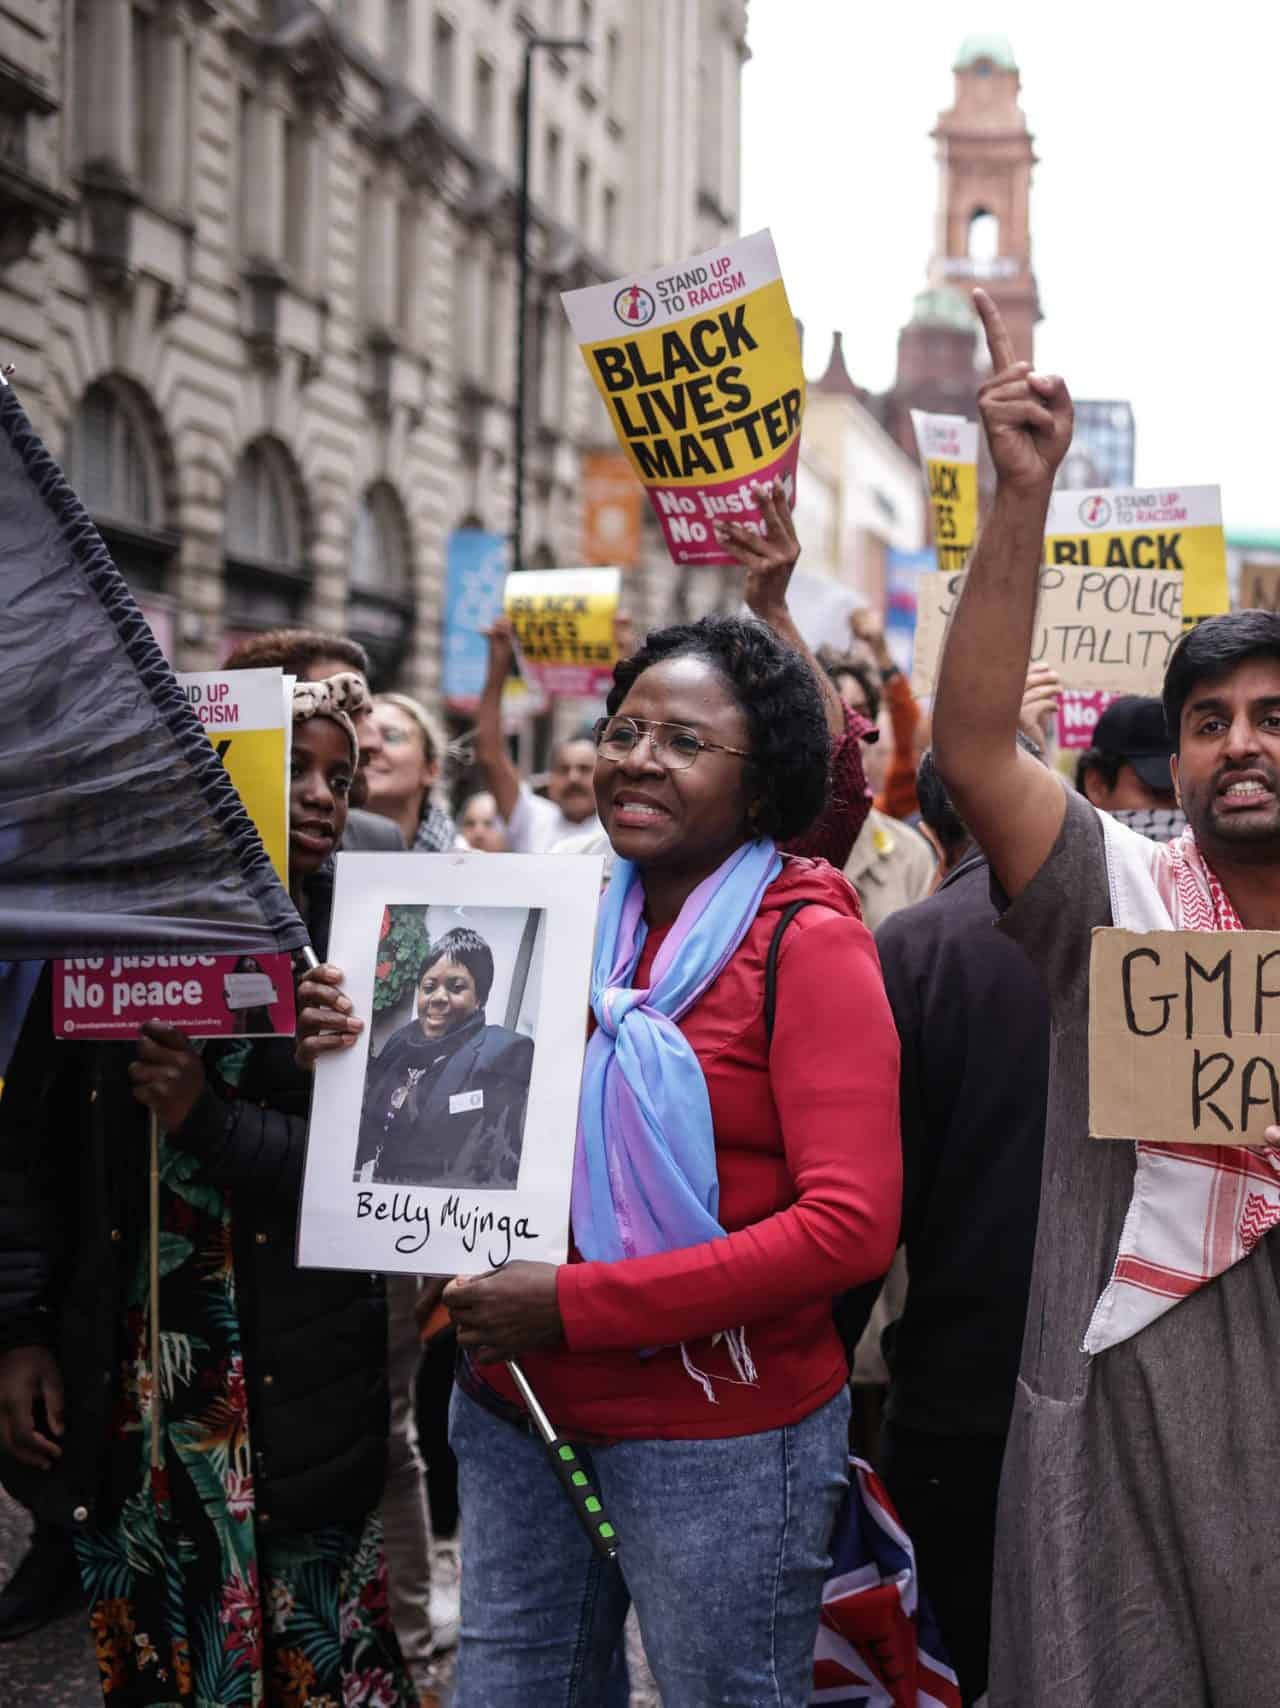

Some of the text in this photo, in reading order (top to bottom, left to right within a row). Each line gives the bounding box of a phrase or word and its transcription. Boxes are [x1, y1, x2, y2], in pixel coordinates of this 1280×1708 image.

[656, 257, 731, 297] STAND UP
[660, 271, 746, 315] TO RACISM
[592, 304, 759, 393] BLACK
[611, 366, 752, 438] LIVES
[628, 387, 801, 479] MATTER
[656, 491, 697, 514] No
[1114, 492, 1179, 508] STAND UP
[1117, 508, 1187, 524] TO RACISM
[668, 516, 708, 543] No
[1077, 571, 1184, 620] POLICE
[207, 683, 229, 703] UP
[63, 975, 203, 1016] No peace
[356, 1191, 430, 1254] Belly
